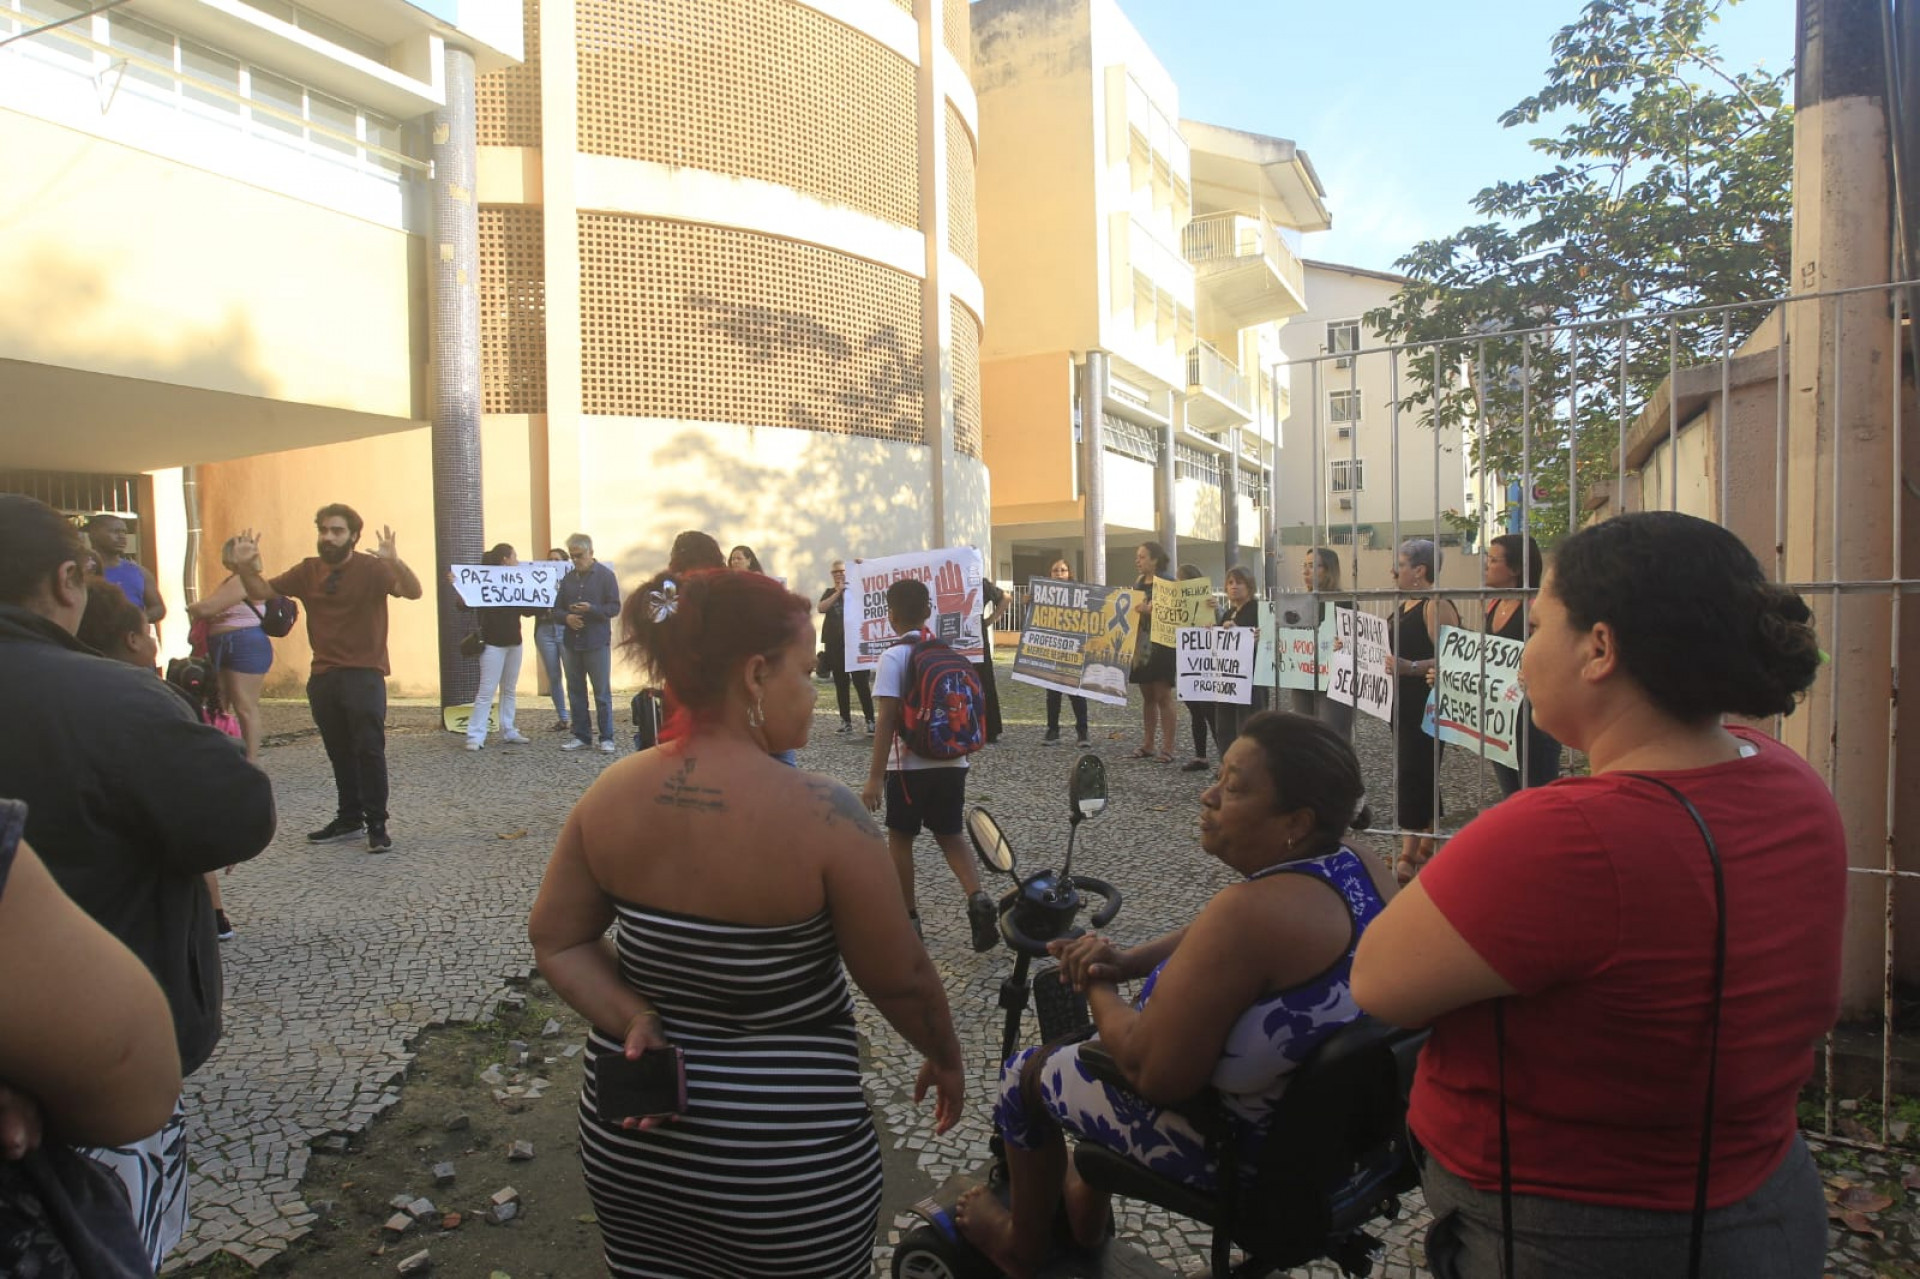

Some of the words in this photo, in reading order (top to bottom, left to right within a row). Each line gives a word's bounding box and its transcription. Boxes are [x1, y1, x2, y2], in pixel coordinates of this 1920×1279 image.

[461, 568, 492, 585] PAZ
[501, 572, 524, 584] NAS
[481, 586, 550, 604] ESCOLAS
[1033, 584, 1069, 607] BASTA
[1073, 588, 1091, 609] DE
[1031, 604, 1105, 636] AGRESSÃO!
[1028, 632, 1075, 651] PROFESSOR
[1182, 631, 1212, 650] PELO
[1217, 630, 1241, 651] FIM
[1187, 656, 1240, 673] VIOLNCIA
[1193, 679, 1237, 696] PROFSSOR
[1439, 693, 1515, 746] RESPETO!
